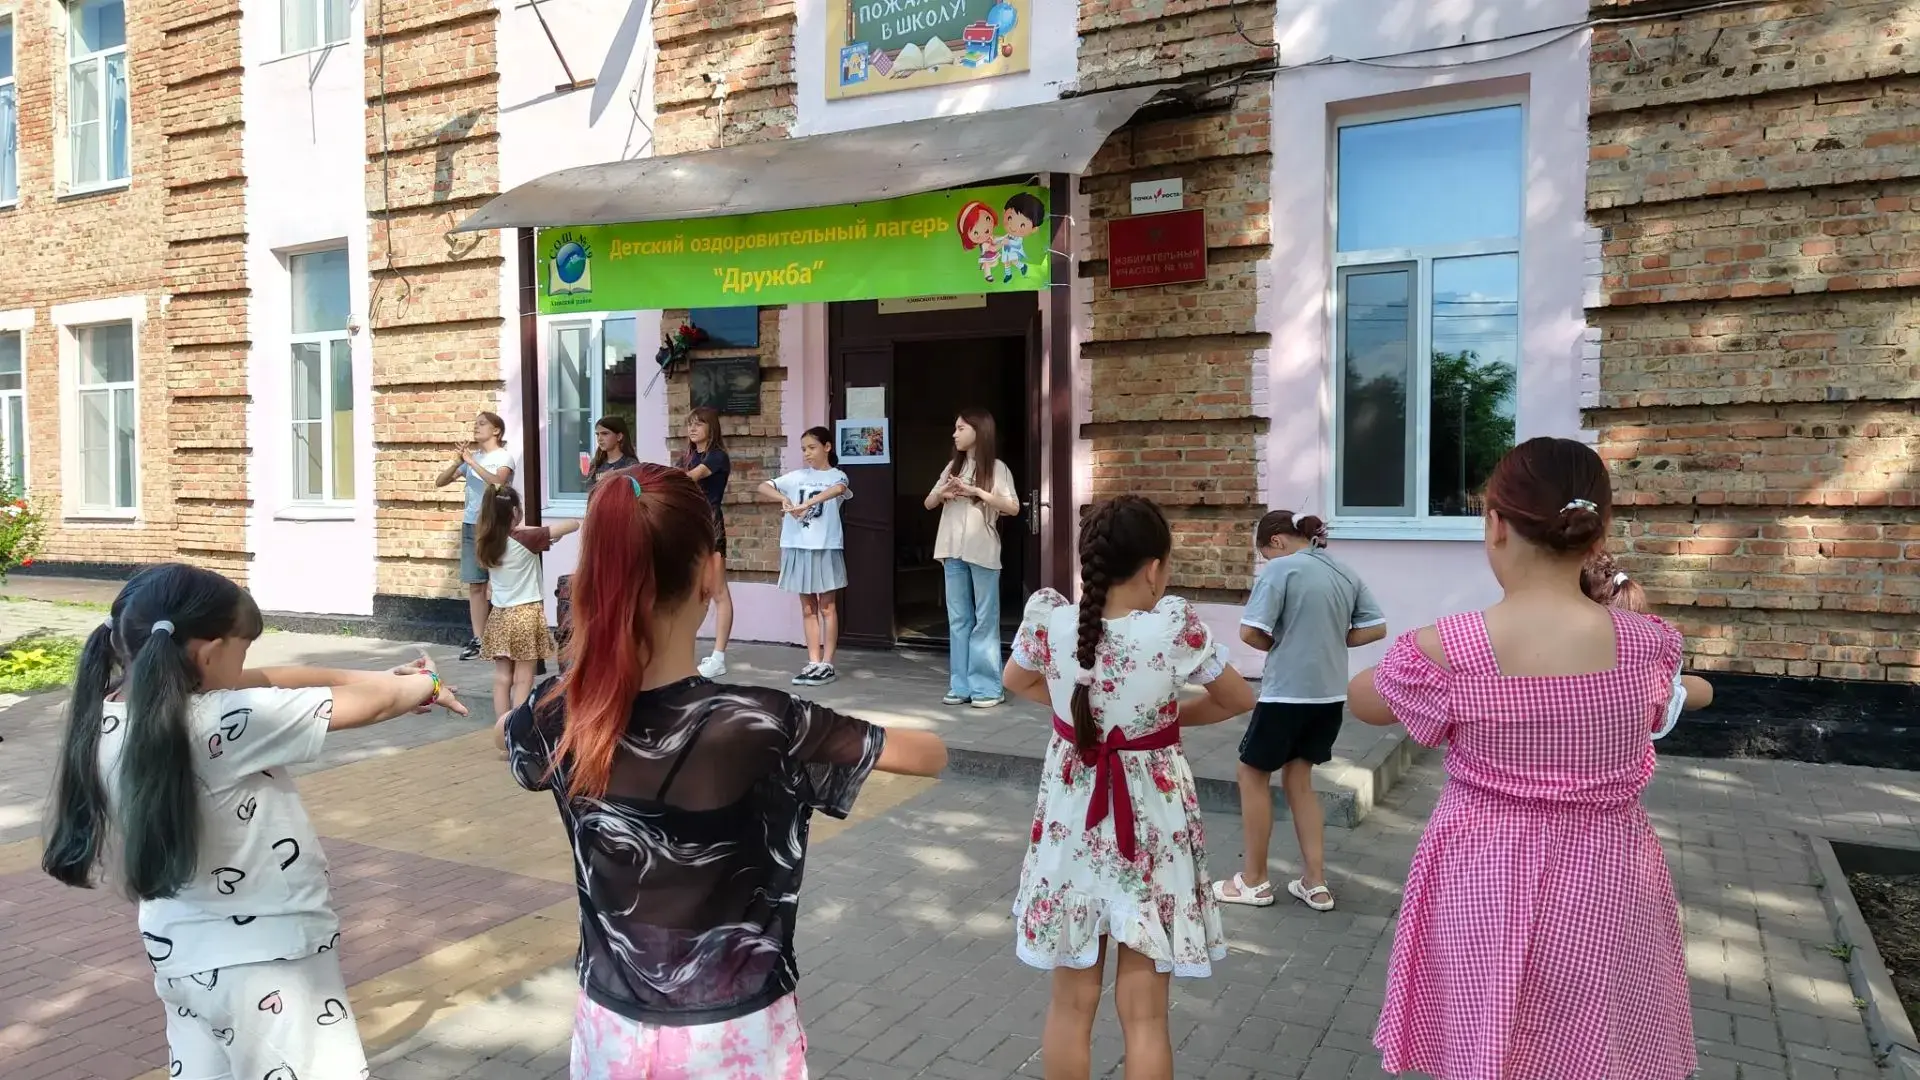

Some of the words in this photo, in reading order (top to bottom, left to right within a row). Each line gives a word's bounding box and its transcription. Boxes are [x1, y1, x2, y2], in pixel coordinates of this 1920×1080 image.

[881, 22, 893, 40] В
[896, 0, 967, 35] ШКОЛУ!
[549, 231, 573, 259] СОШ
[609, 234, 684, 262] Детский
[690, 219, 867, 255] оздоровительный
[874, 215, 949, 239] лагерь
[1114, 249, 1200, 265] ИЗБИРАТЕЛЬНЫЙ
[1115, 265, 1161, 277] УЧАСТОК
[1164, 263, 1176, 272] №
